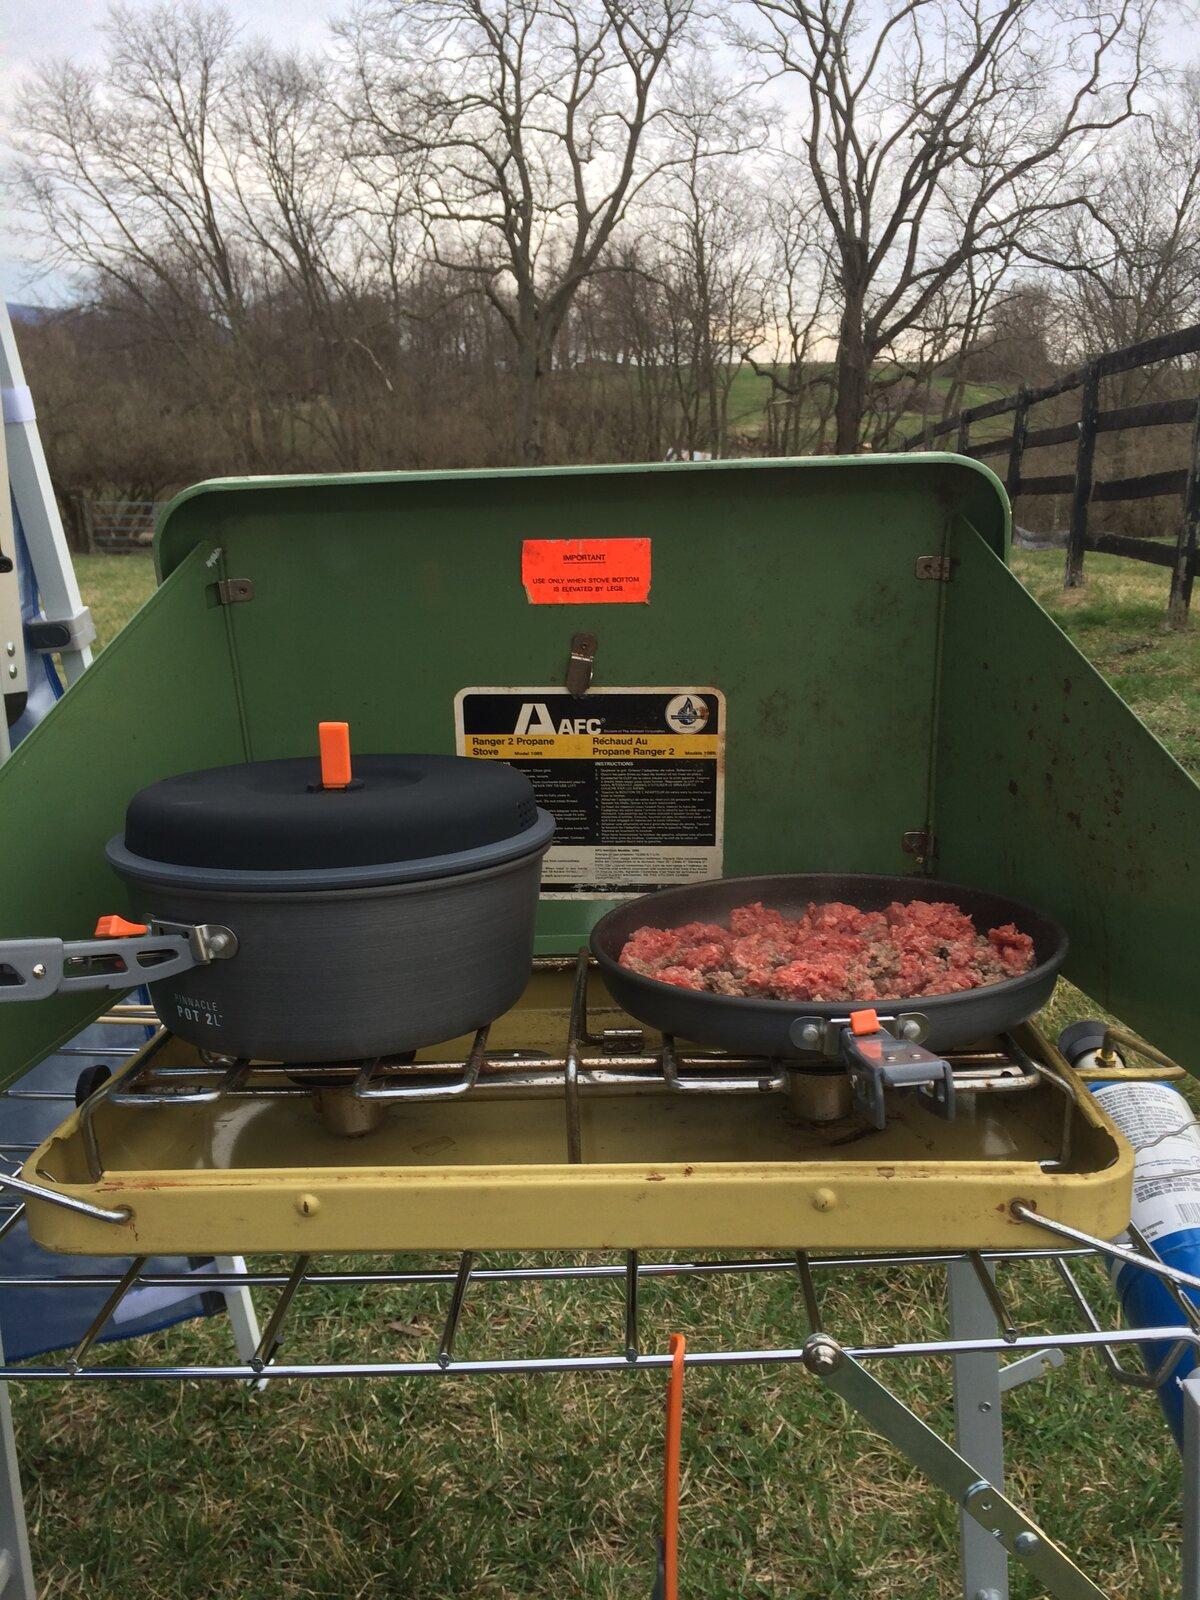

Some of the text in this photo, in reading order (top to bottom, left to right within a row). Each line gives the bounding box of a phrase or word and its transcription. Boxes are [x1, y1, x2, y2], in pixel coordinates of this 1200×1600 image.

[472, 737, 555, 747] Ranger 2 Propane
[592, 737, 648, 745] Réchaud Au
[472, 748, 499, 756] Stove
[592, 748, 631, 757] Propane
[633, 748, 666, 757] Ranger
[175, 993, 218, 1011] PINNACLE
[177, 1005, 199, 1022] POT
